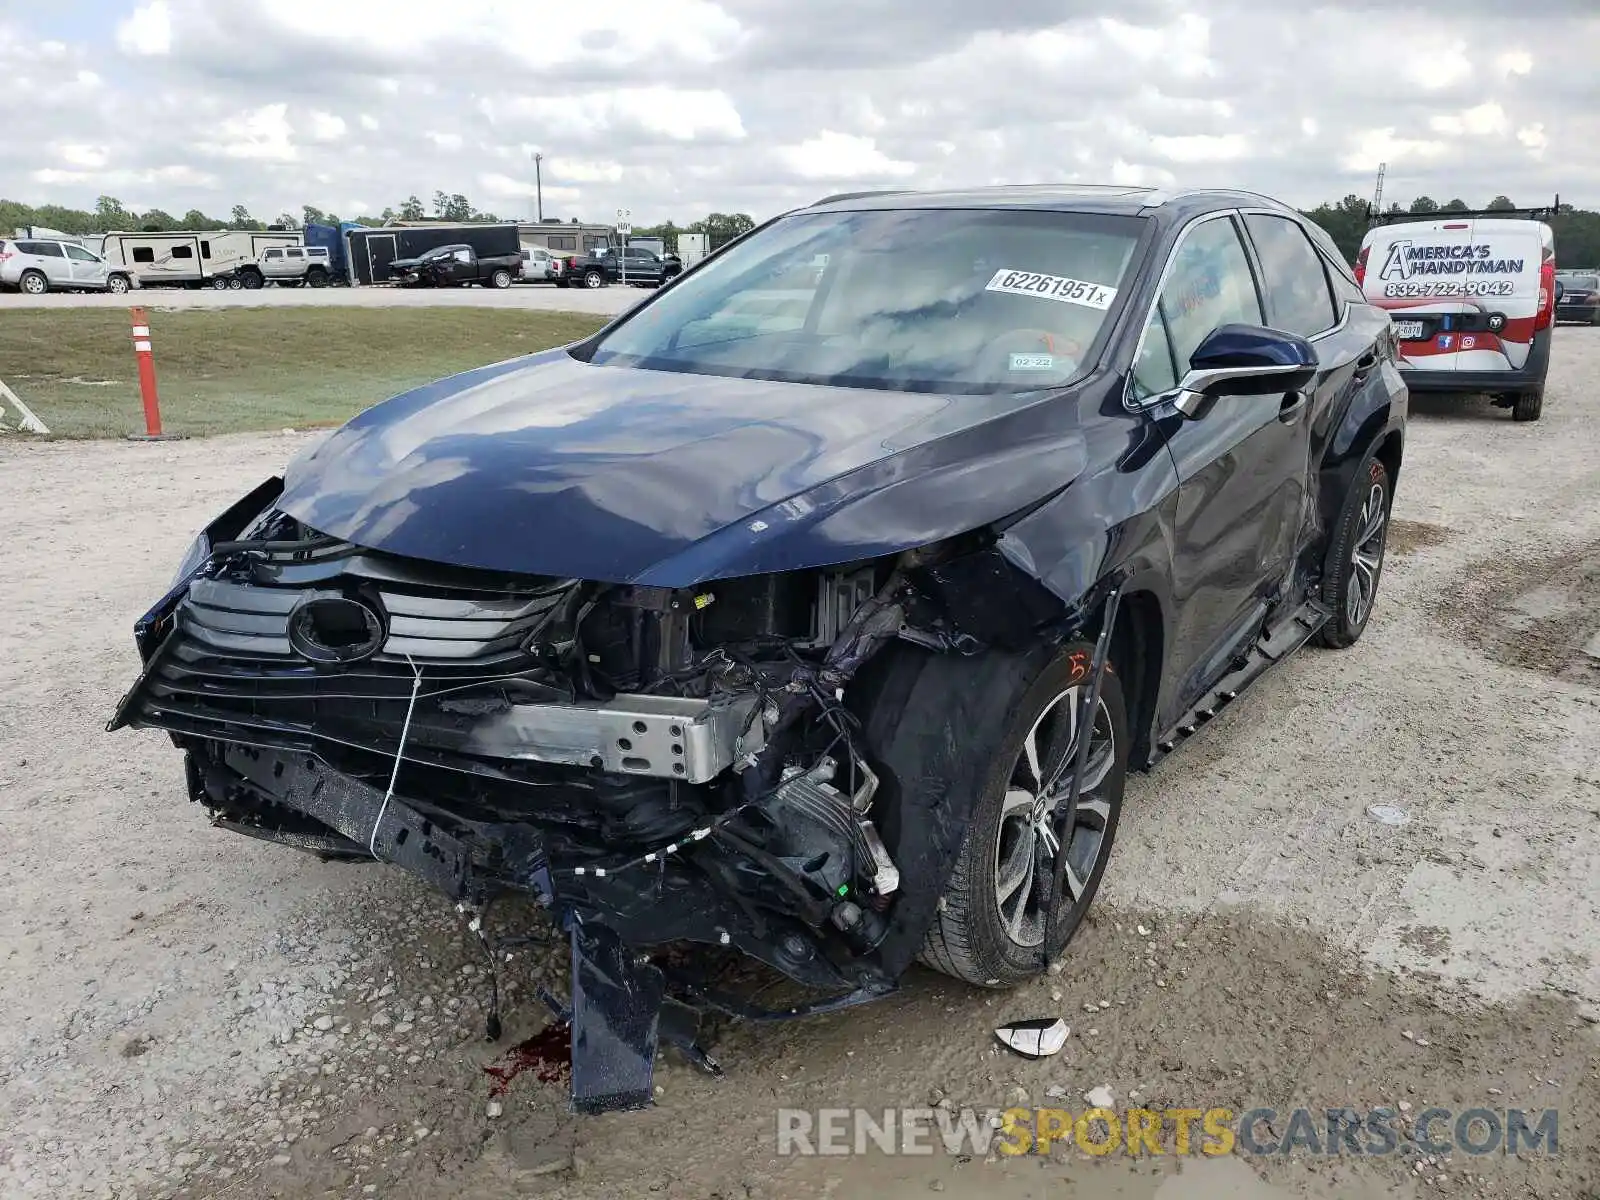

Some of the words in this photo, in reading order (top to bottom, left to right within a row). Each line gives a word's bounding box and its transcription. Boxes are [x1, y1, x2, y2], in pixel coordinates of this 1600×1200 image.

[1380, 240, 1490, 280] AMERICA'S
[1411, 260, 1523, 274] HANDYMAN
[1386, 281, 1514, 297] 832-722-9042
